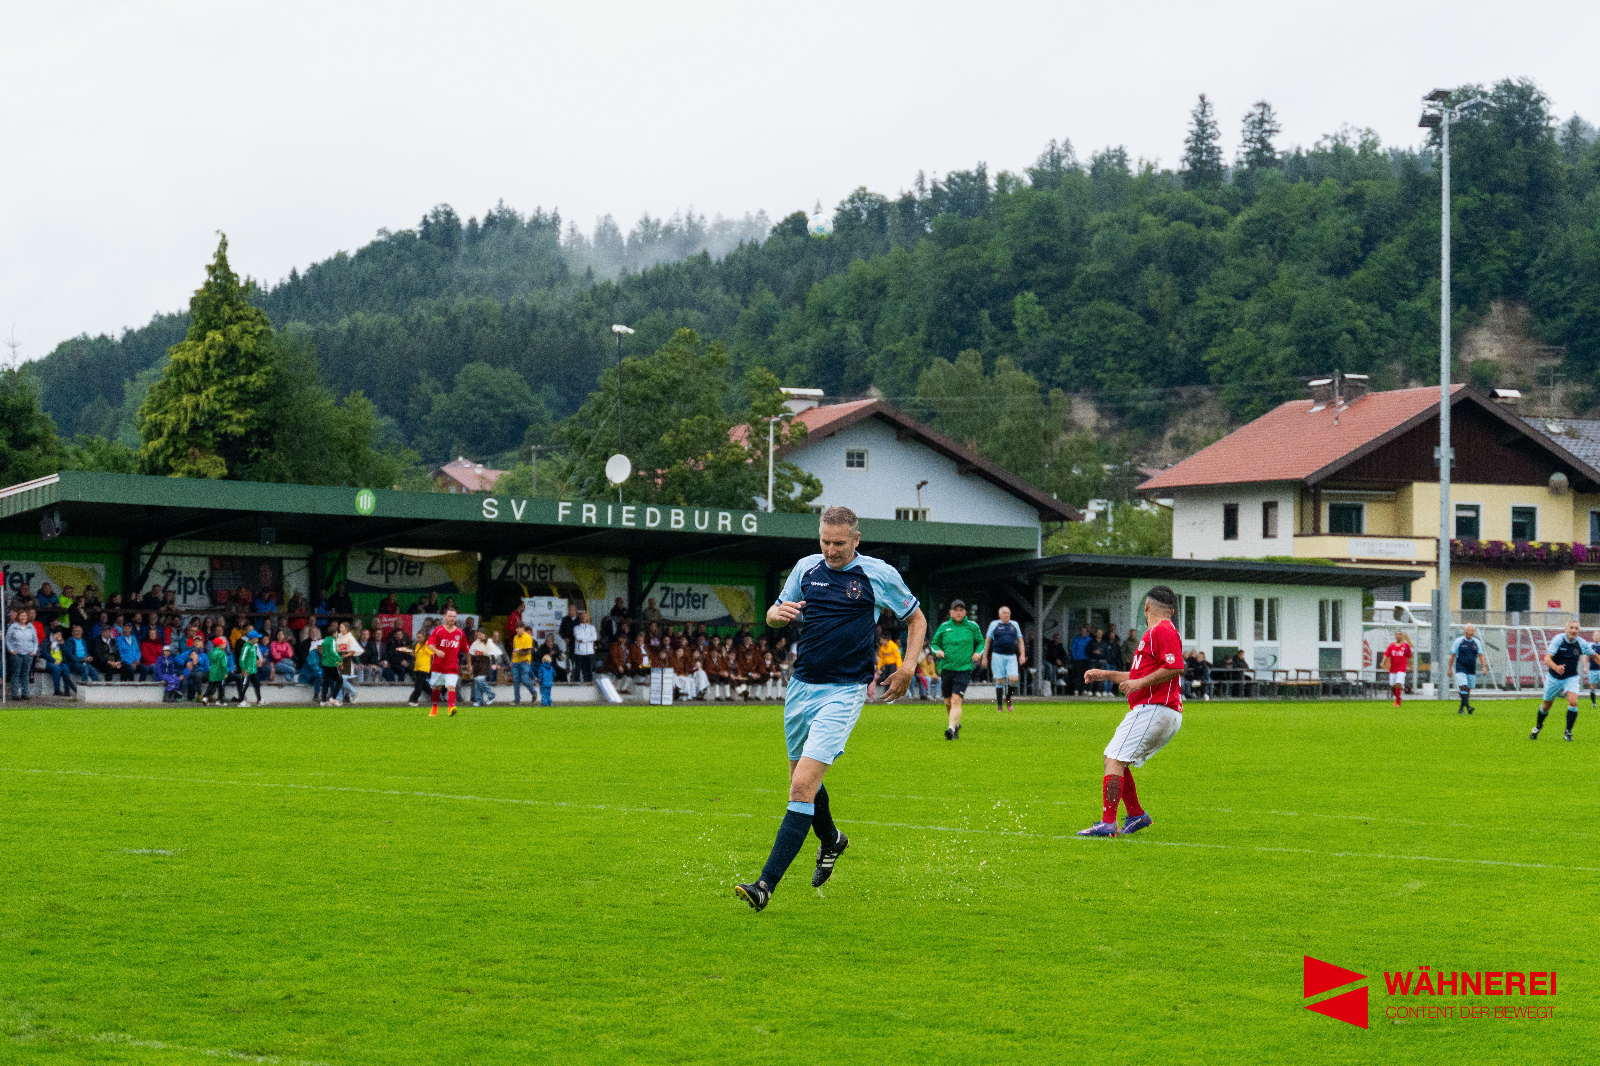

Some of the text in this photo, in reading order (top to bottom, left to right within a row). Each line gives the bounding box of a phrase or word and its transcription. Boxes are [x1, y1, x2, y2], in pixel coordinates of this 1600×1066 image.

[482, 497, 759, 534] SV FRIEDBURG
[366, 551, 425, 583] Zipfer
[659, 585, 709, 616] Zipfer
